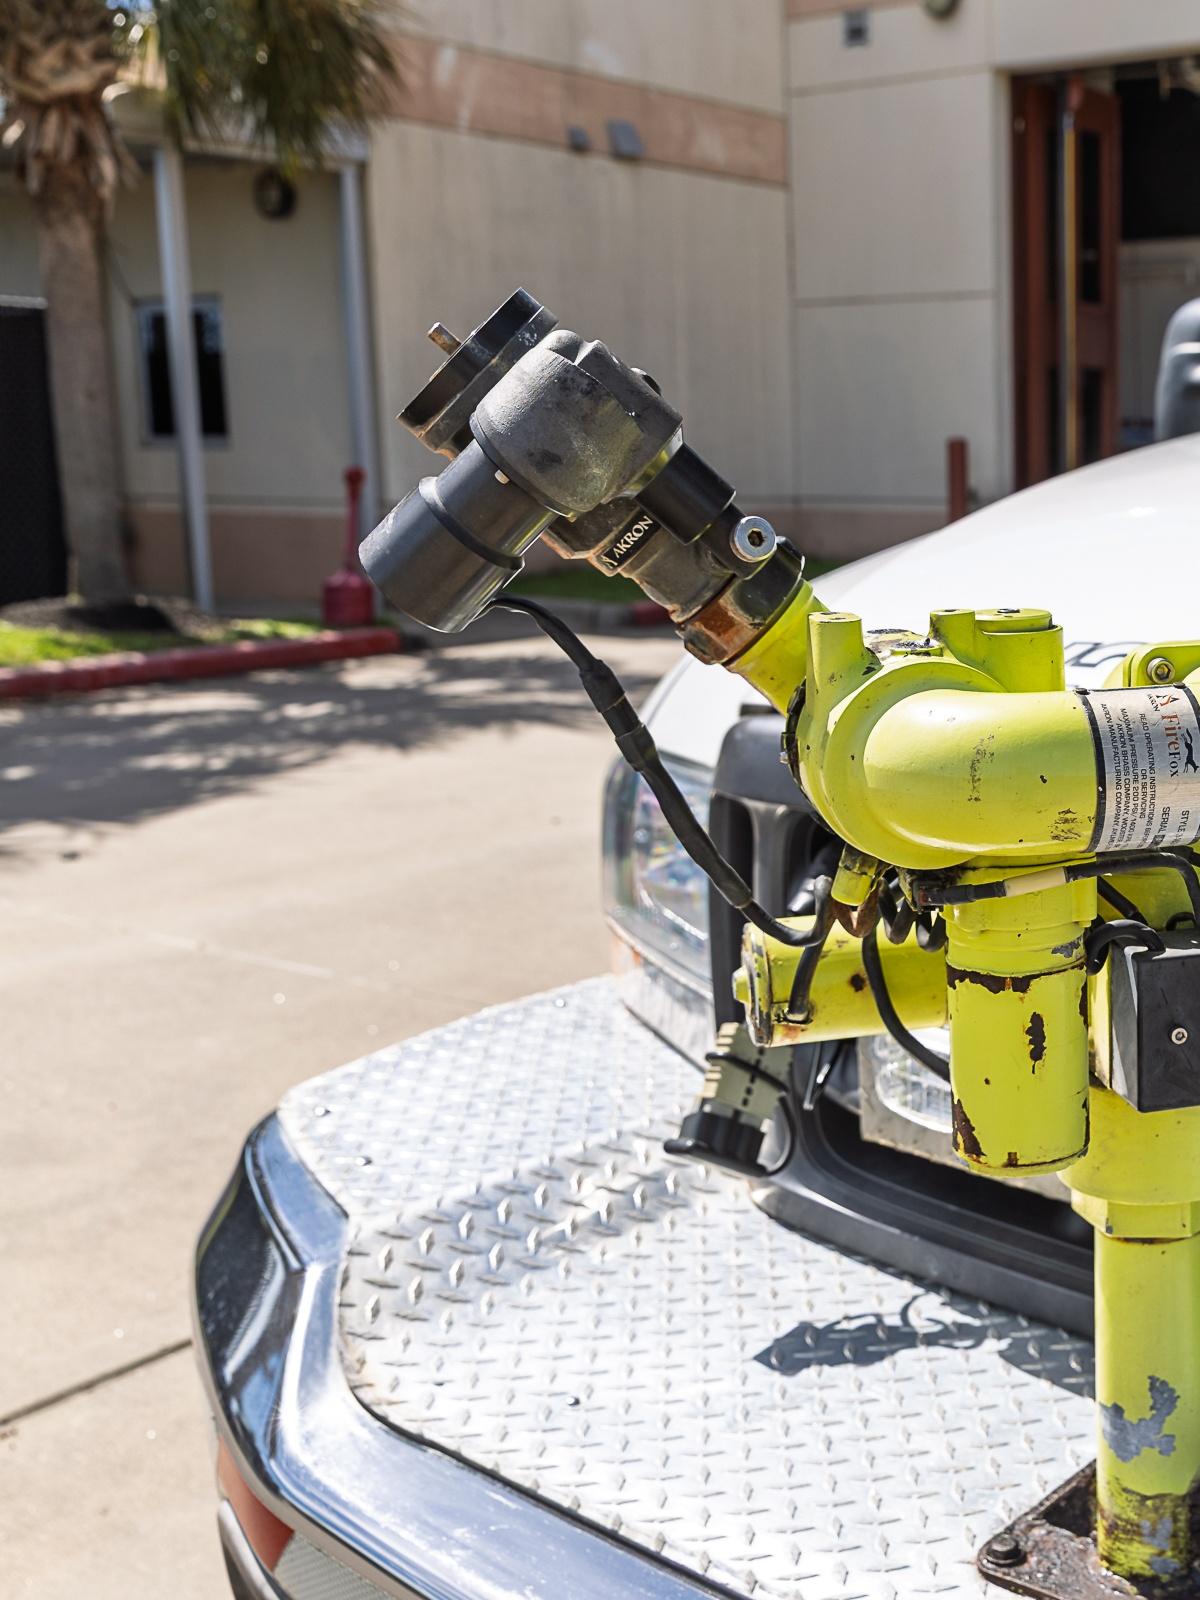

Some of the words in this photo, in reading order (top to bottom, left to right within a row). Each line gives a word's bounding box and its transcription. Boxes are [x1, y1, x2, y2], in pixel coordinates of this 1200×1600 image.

[613, 515, 653, 558] AKRON
[1116, 723, 1127, 748] AKRON
[1139, 713, 1149, 731] READ
[1101, 704, 1113, 724] AKRON
[1108, 724, 1122, 790] MANUFACTURING
[1121, 708, 1135, 742] MAXIMUM
[1129, 743, 1140, 784] PRESSURE
[1144, 732, 1156, 775] OPERATING
[1121, 750, 1130, 777] BRASS
[1140, 769, 1148, 780] OR
[1139, 781, 1148, 819] SERVICING
[1146, 776, 1157, 827] INSTRUCTIONS
[1157, 806, 1170, 833] SERIAL
[1177, 810, 1190, 832] STYLE
